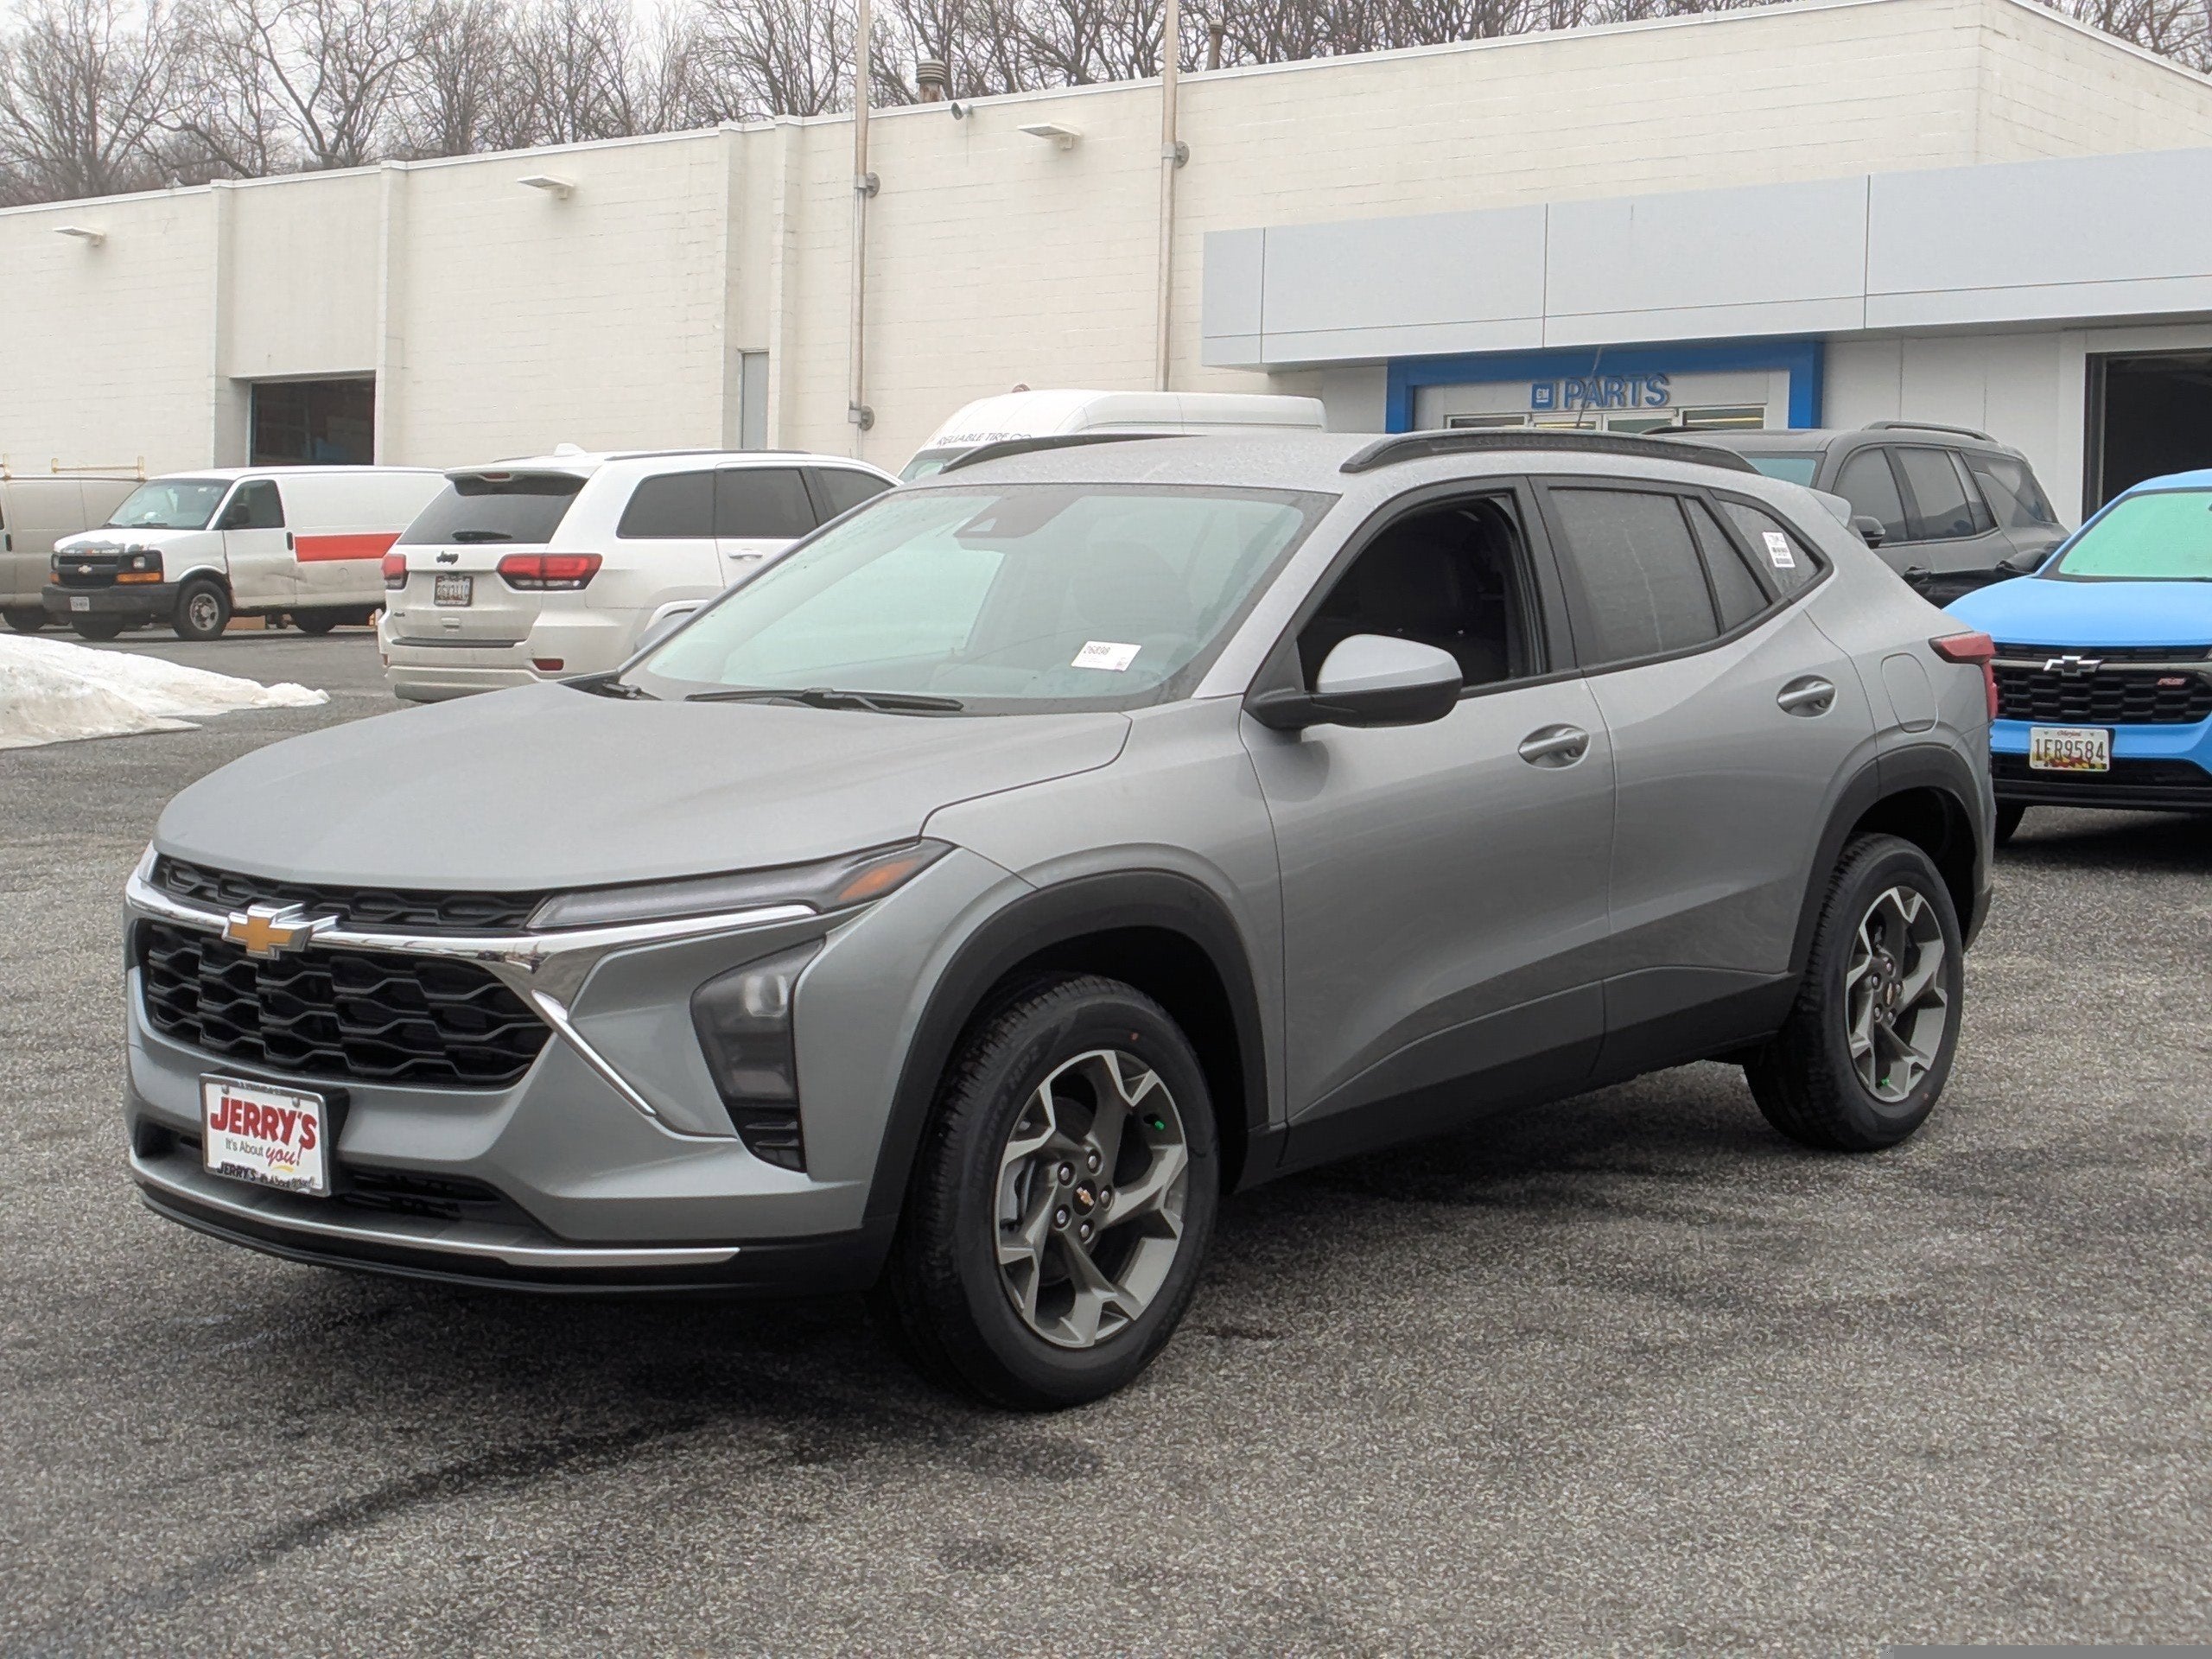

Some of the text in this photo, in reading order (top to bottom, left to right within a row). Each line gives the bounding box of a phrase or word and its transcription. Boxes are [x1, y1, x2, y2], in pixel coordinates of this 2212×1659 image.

[1564, 375, 1670, 409] PARTS
[936, 432, 984, 447] RELIABLE
[985, 432, 1010, 442] TIRE
[210, 1096, 317, 1150] JERRY'S
[225, 1137, 303, 1167] It's About you!
